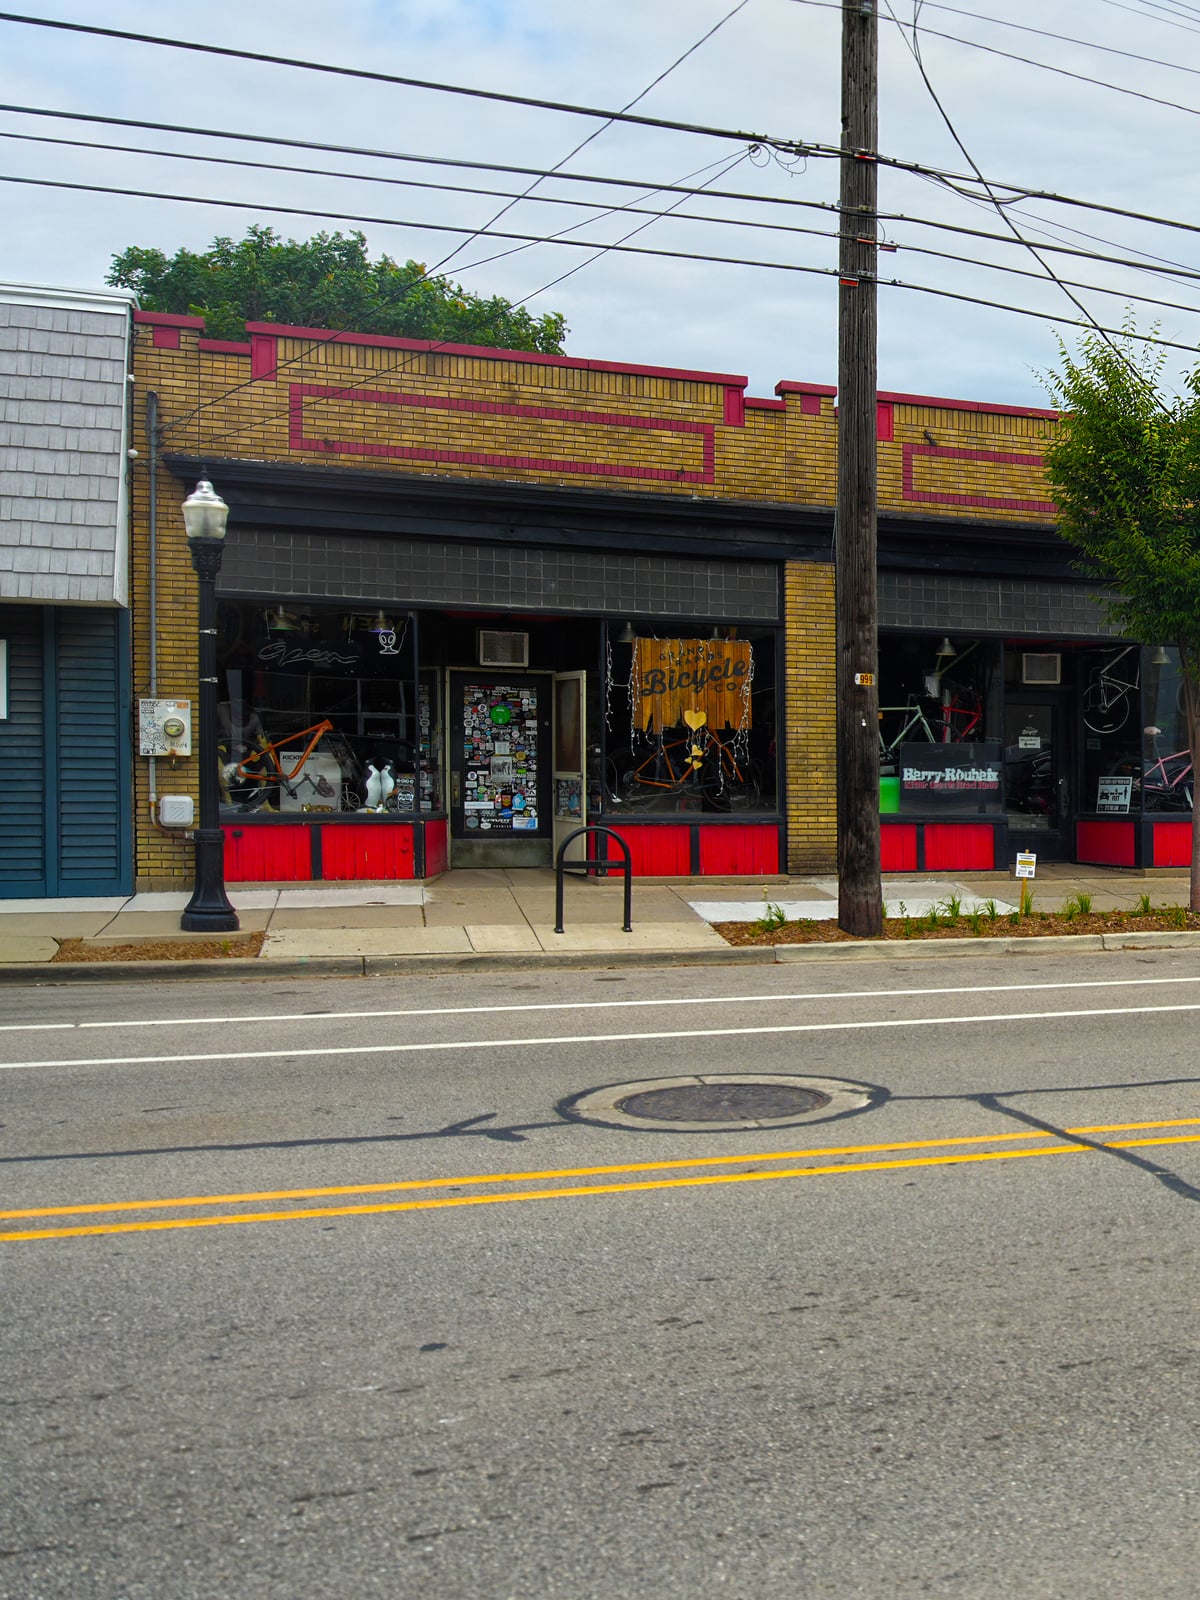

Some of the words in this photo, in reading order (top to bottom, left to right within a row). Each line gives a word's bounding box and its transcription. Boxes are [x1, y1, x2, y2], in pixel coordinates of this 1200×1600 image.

[659, 646, 705, 661] GRAND
[640, 657, 749, 697] Bicycle
[860, 674, 873, 685] 999
[902, 767, 999, 784] Barry-Roubaix
